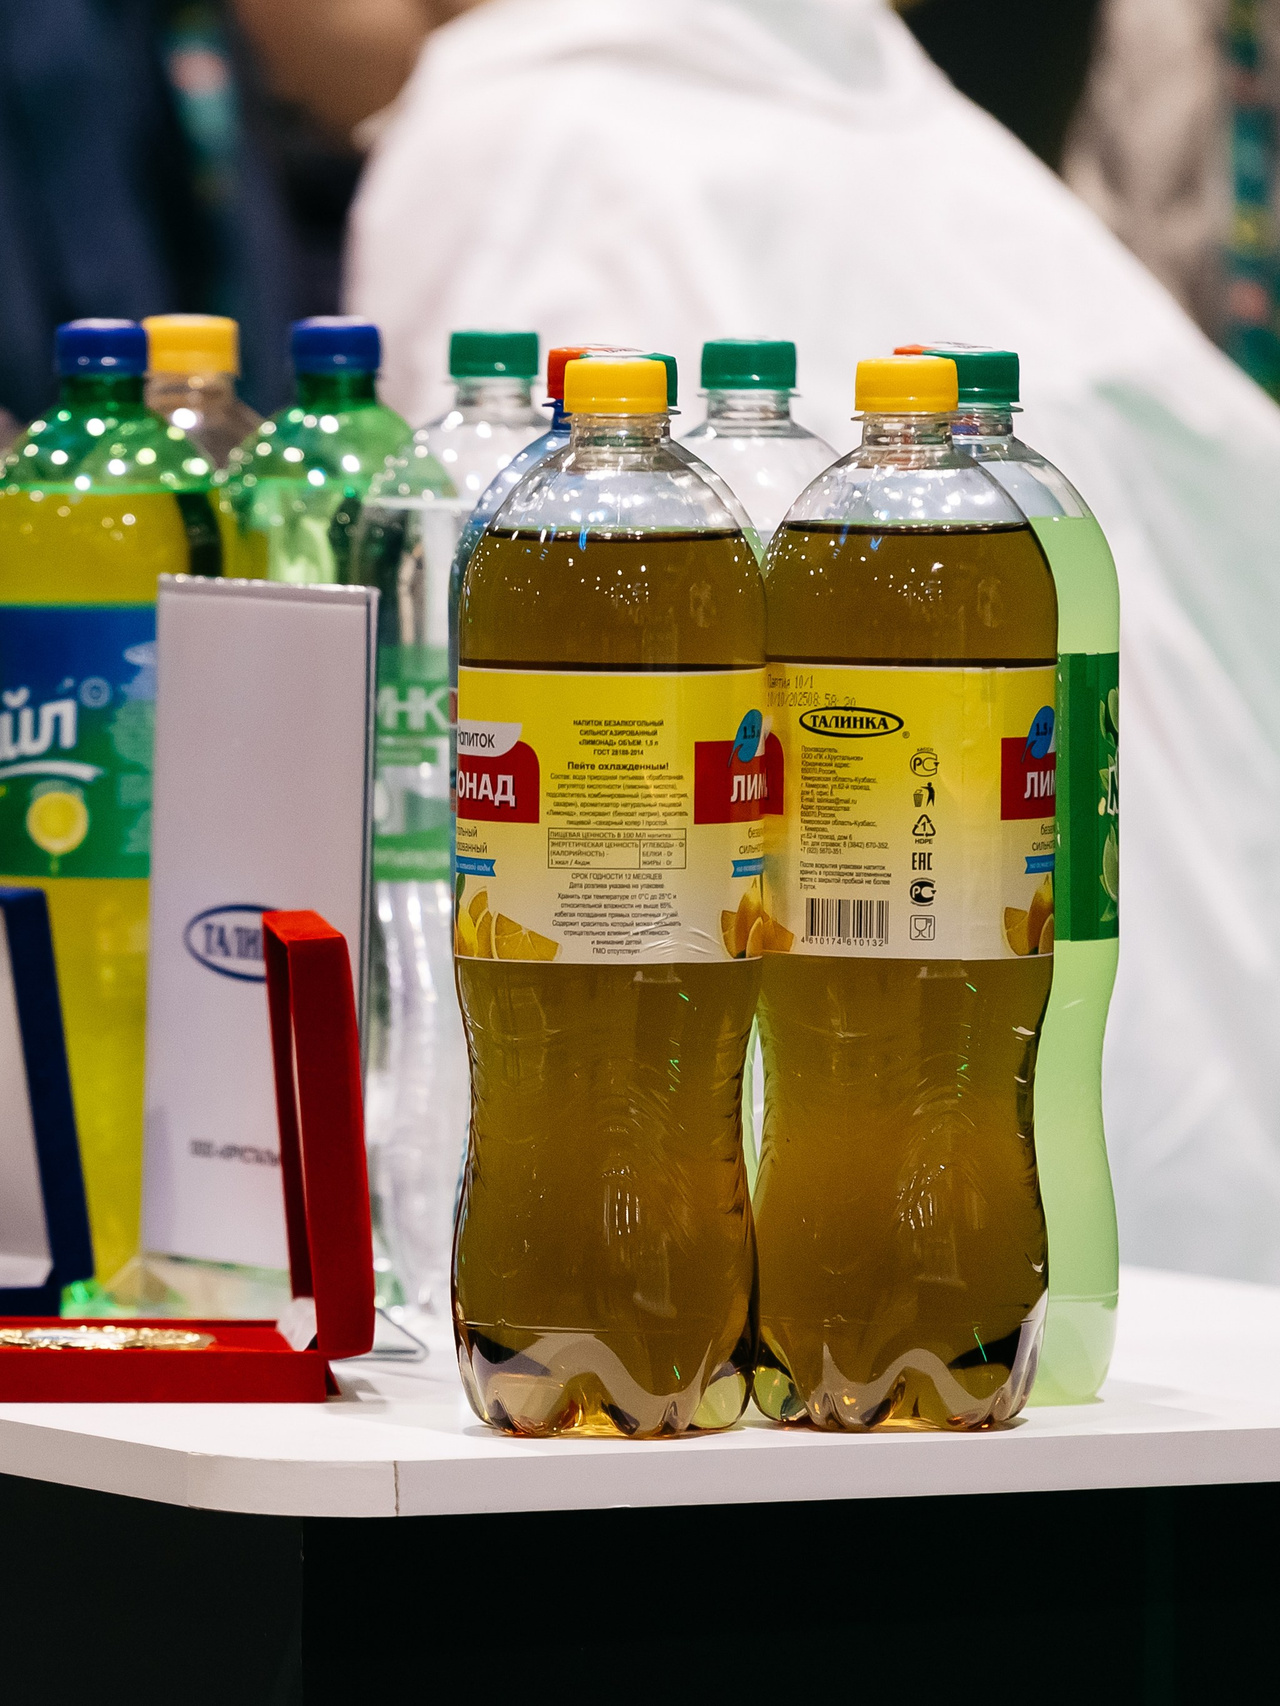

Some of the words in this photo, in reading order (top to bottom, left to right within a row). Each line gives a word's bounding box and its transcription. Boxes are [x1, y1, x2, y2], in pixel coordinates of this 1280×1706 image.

[768, 674, 790, 688] Партия
[795, 675, 813, 689] 10/1
[810, 715, 889, 729] ТАЛИНКА
[567, 762, 595, 770] Пейте
[598, 763, 669, 771] охлажденным!
